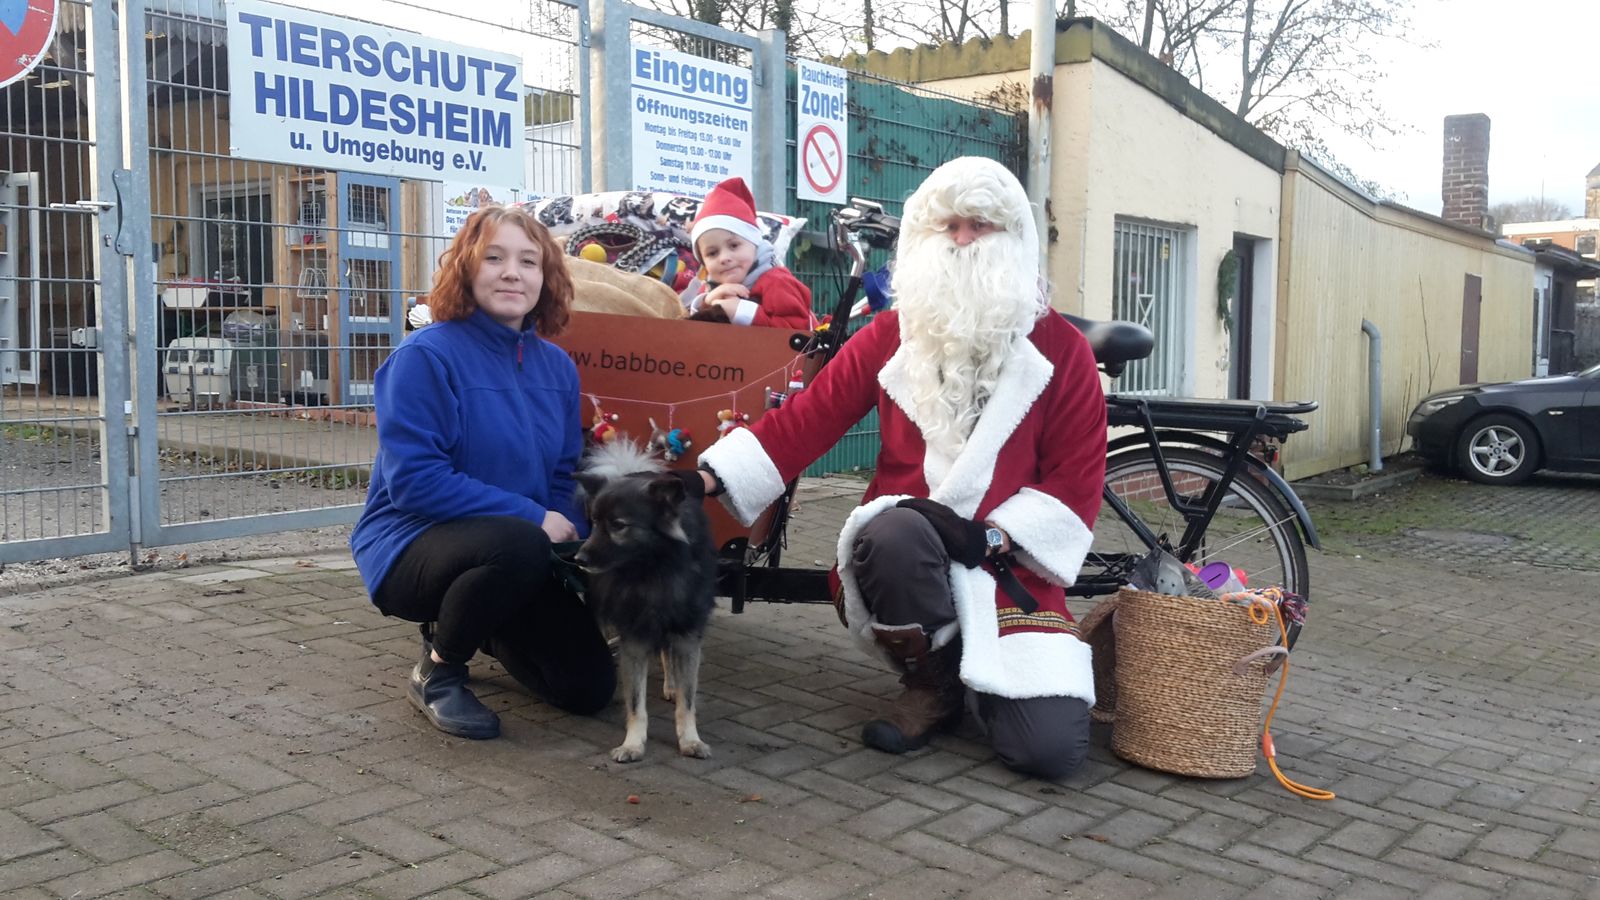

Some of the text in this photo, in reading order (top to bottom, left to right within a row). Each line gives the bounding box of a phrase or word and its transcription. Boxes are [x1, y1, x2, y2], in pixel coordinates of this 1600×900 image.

[239, 11, 518, 102] TIERSCHUTZ
[636, 49, 748, 104] Eingang
[802, 65, 844, 89] Rauchfreie
[254, 71, 512, 149] HILDESHEIM
[636, 94, 748, 132] Öffnungszeiten
[802, 84, 844, 122] Zone!
[290, 130, 487, 172] u. Umgebung e.V.
[644, 122, 666, 136] Montag
[668, 126, 676, 136] bis
[678, 128, 697, 141] Freitag
[733, 138, 741, 148] Uhr
[656, 140, 688, 155] Donnerstag
[723, 151, 732, 160] Uhr
[660, 157, 683, 170] Samstag
[719, 166, 728, 175] Uhr
[668, 175, 679, 183] und
[681, 175, 705, 188] Feiertags
